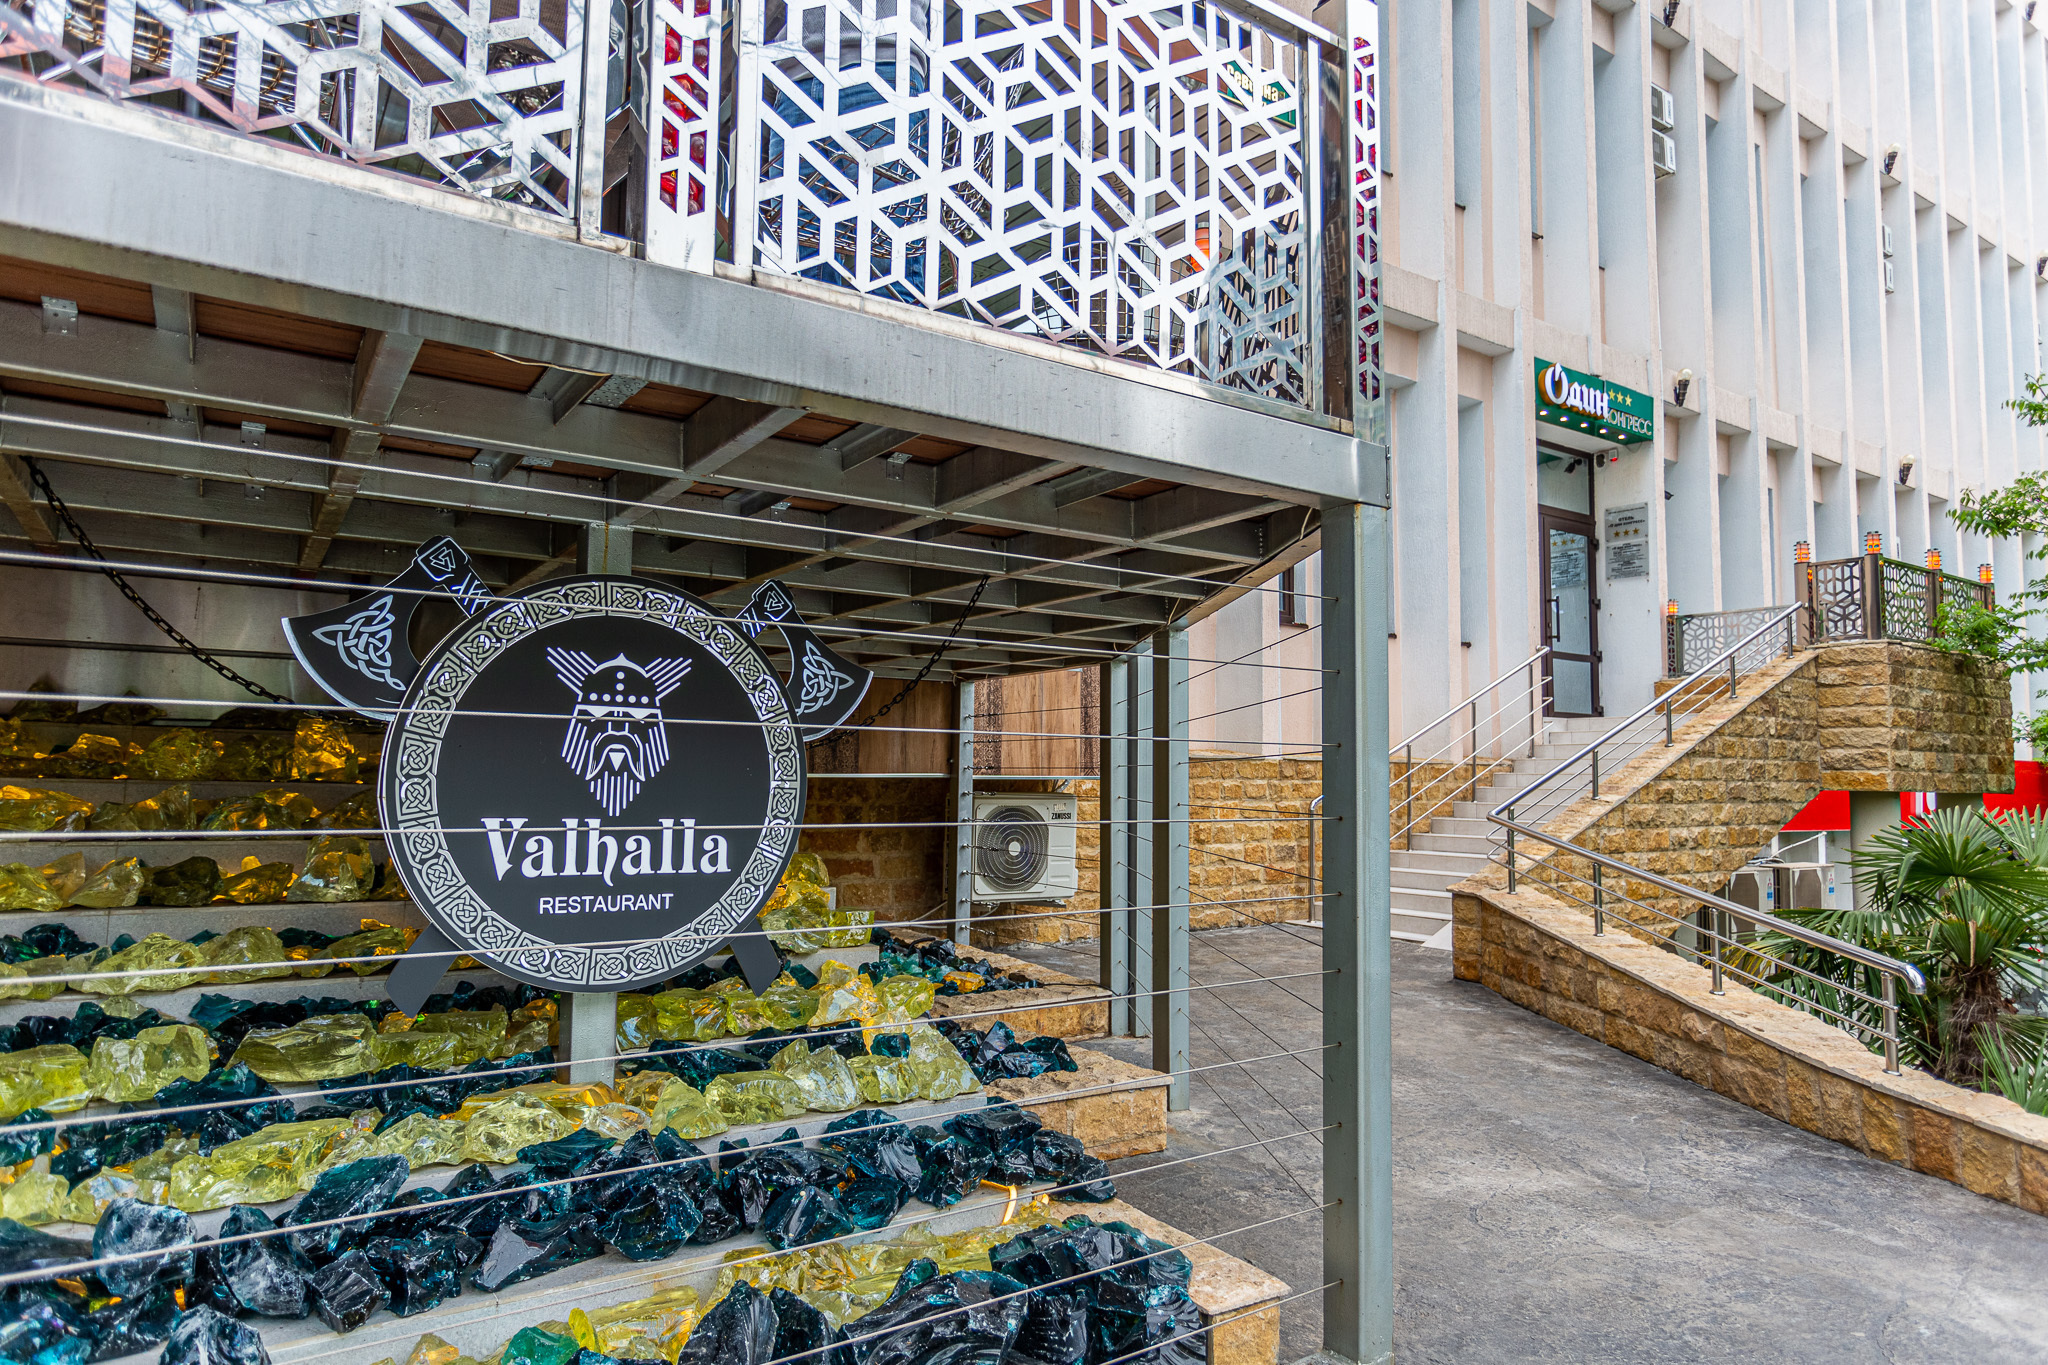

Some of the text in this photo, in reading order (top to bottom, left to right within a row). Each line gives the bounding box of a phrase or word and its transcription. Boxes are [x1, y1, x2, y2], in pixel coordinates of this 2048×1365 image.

[1542, 362, 1610, 418] Один
[1051, 812, 1072, 820] ZANUSSI
[481, 818, 731, 887] Valhalla
[538, 893, 674, 914] RESTAURANT
